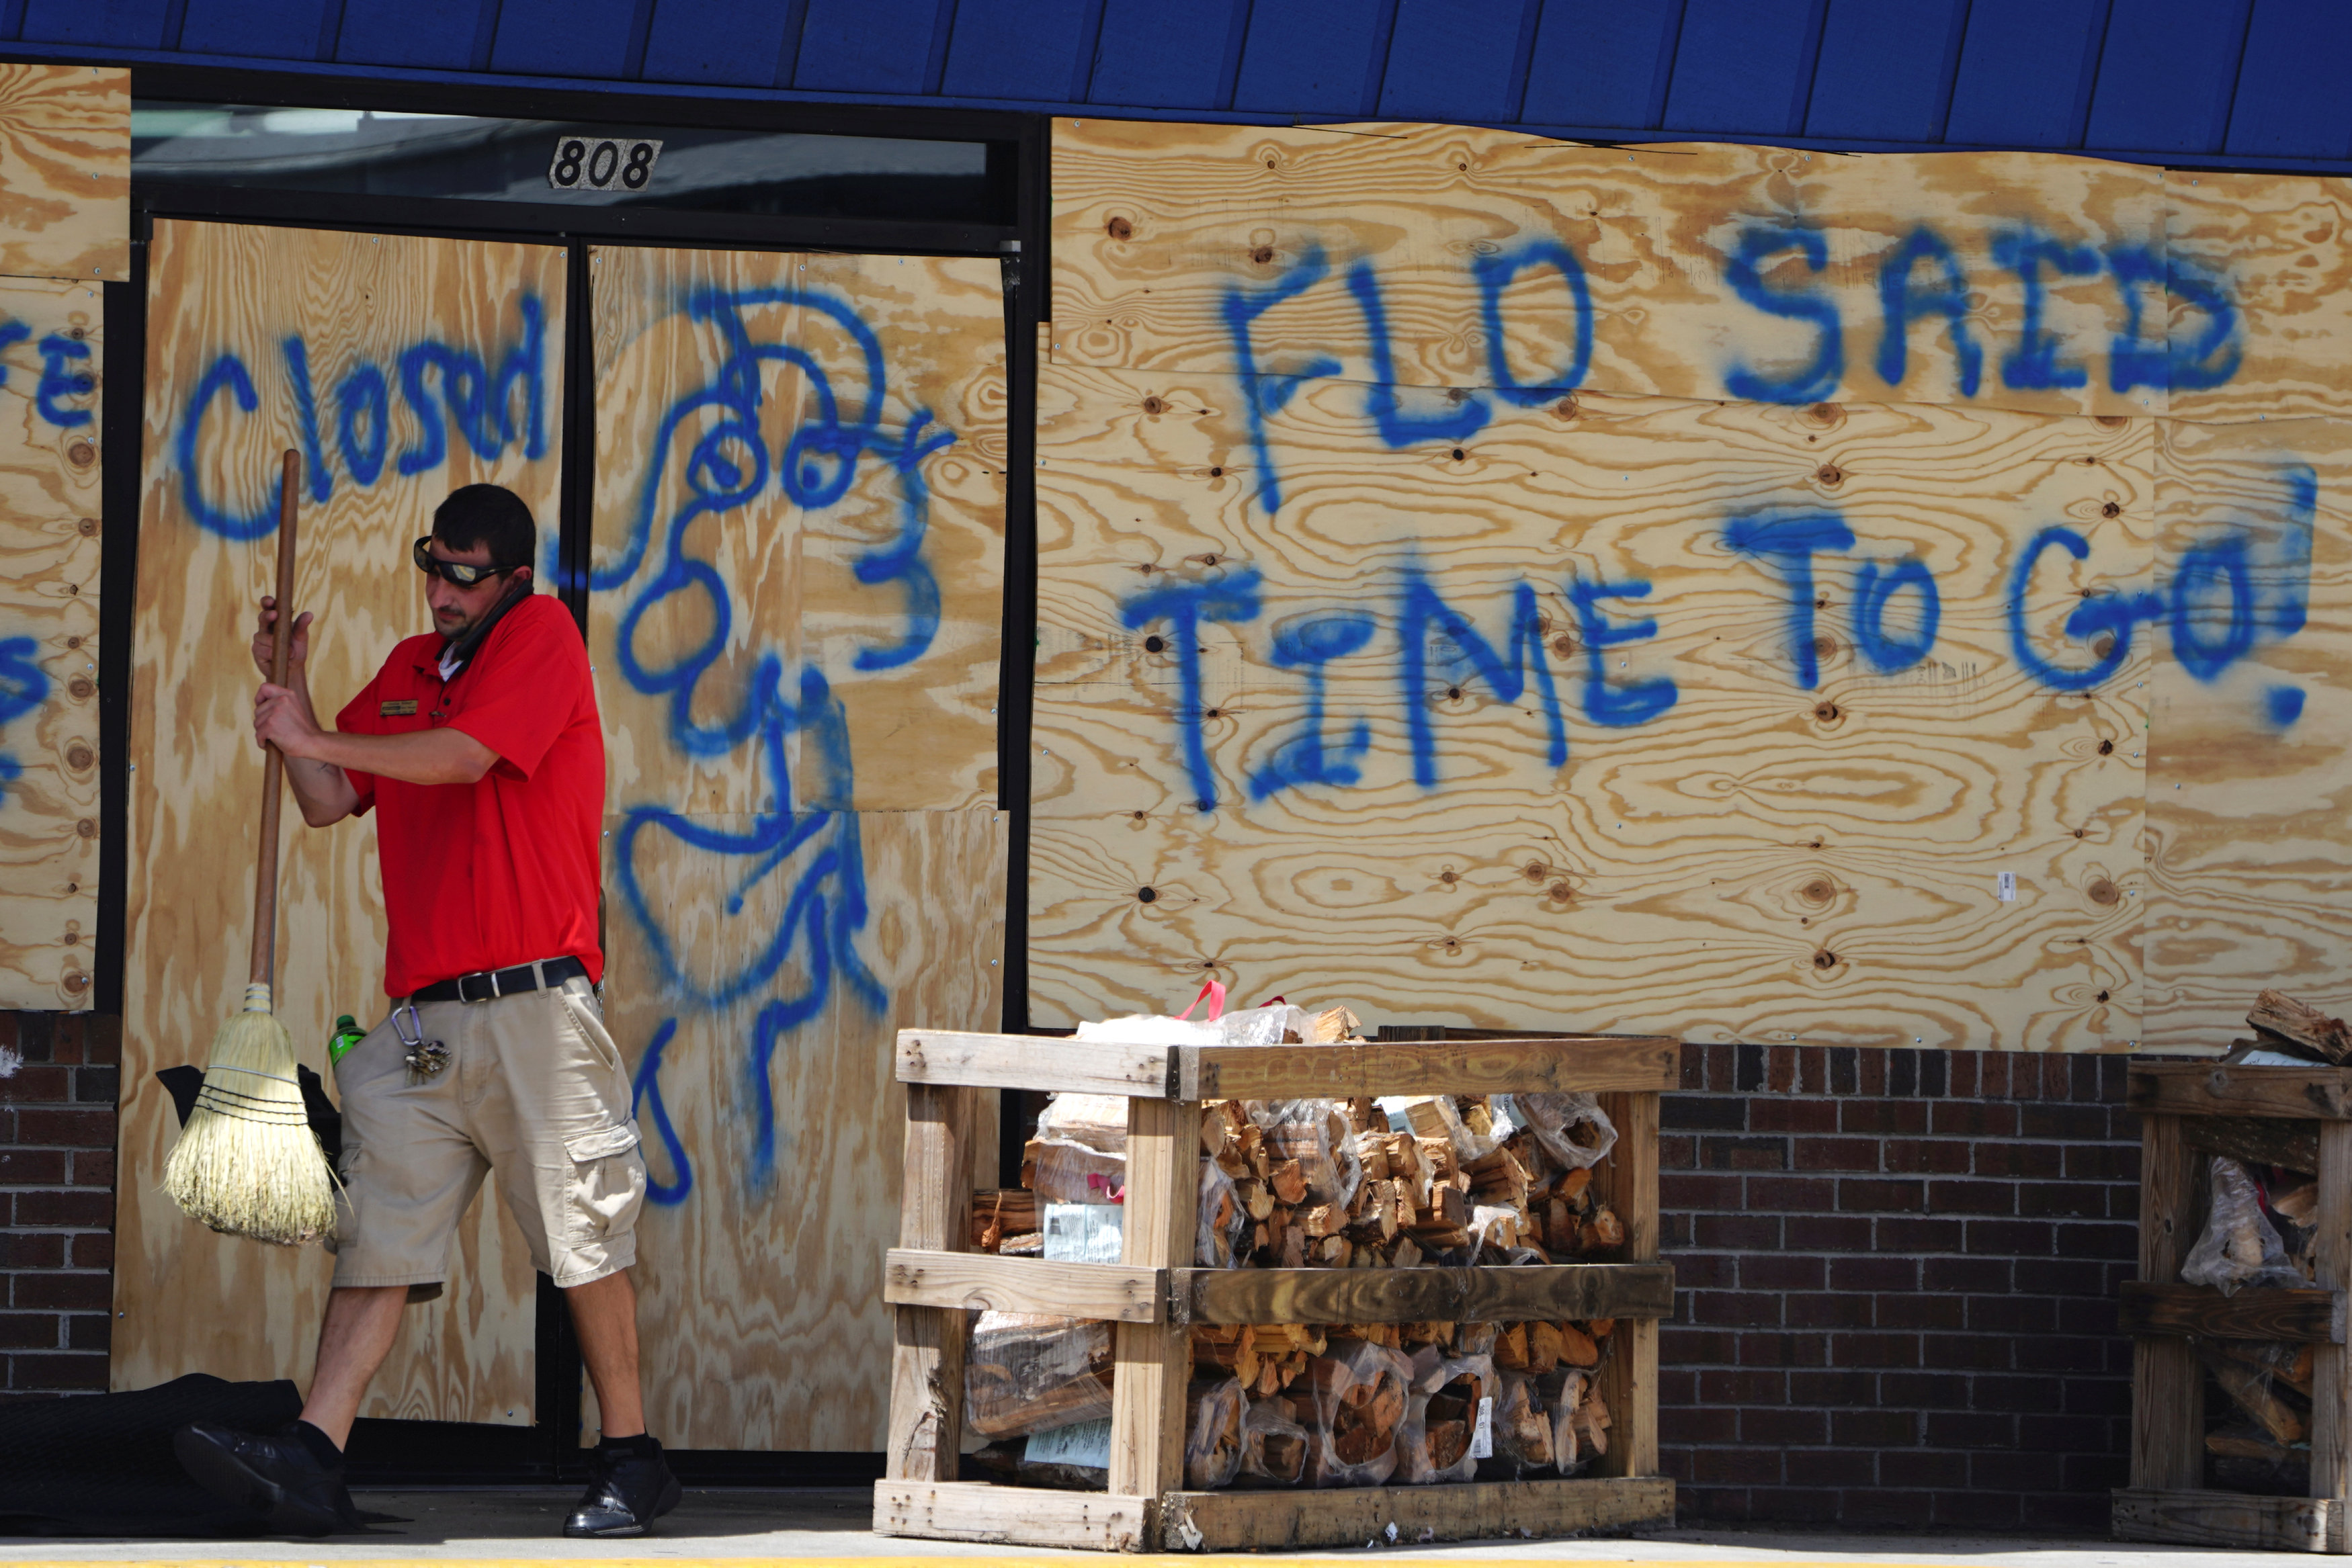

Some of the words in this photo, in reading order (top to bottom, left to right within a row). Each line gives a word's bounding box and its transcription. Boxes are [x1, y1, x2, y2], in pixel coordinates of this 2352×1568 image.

[555, 140, 653, 189] 808
[174, 292, 548, 540] Closed
[1219, 236, 1595, 514] FLO
[1722, 222, 2241, 406] SAID
[1118, 558, 1679, 816] TIME
[1720, 509, 1941, 691] TO
[2007, 468, 2318, 730] GO!
